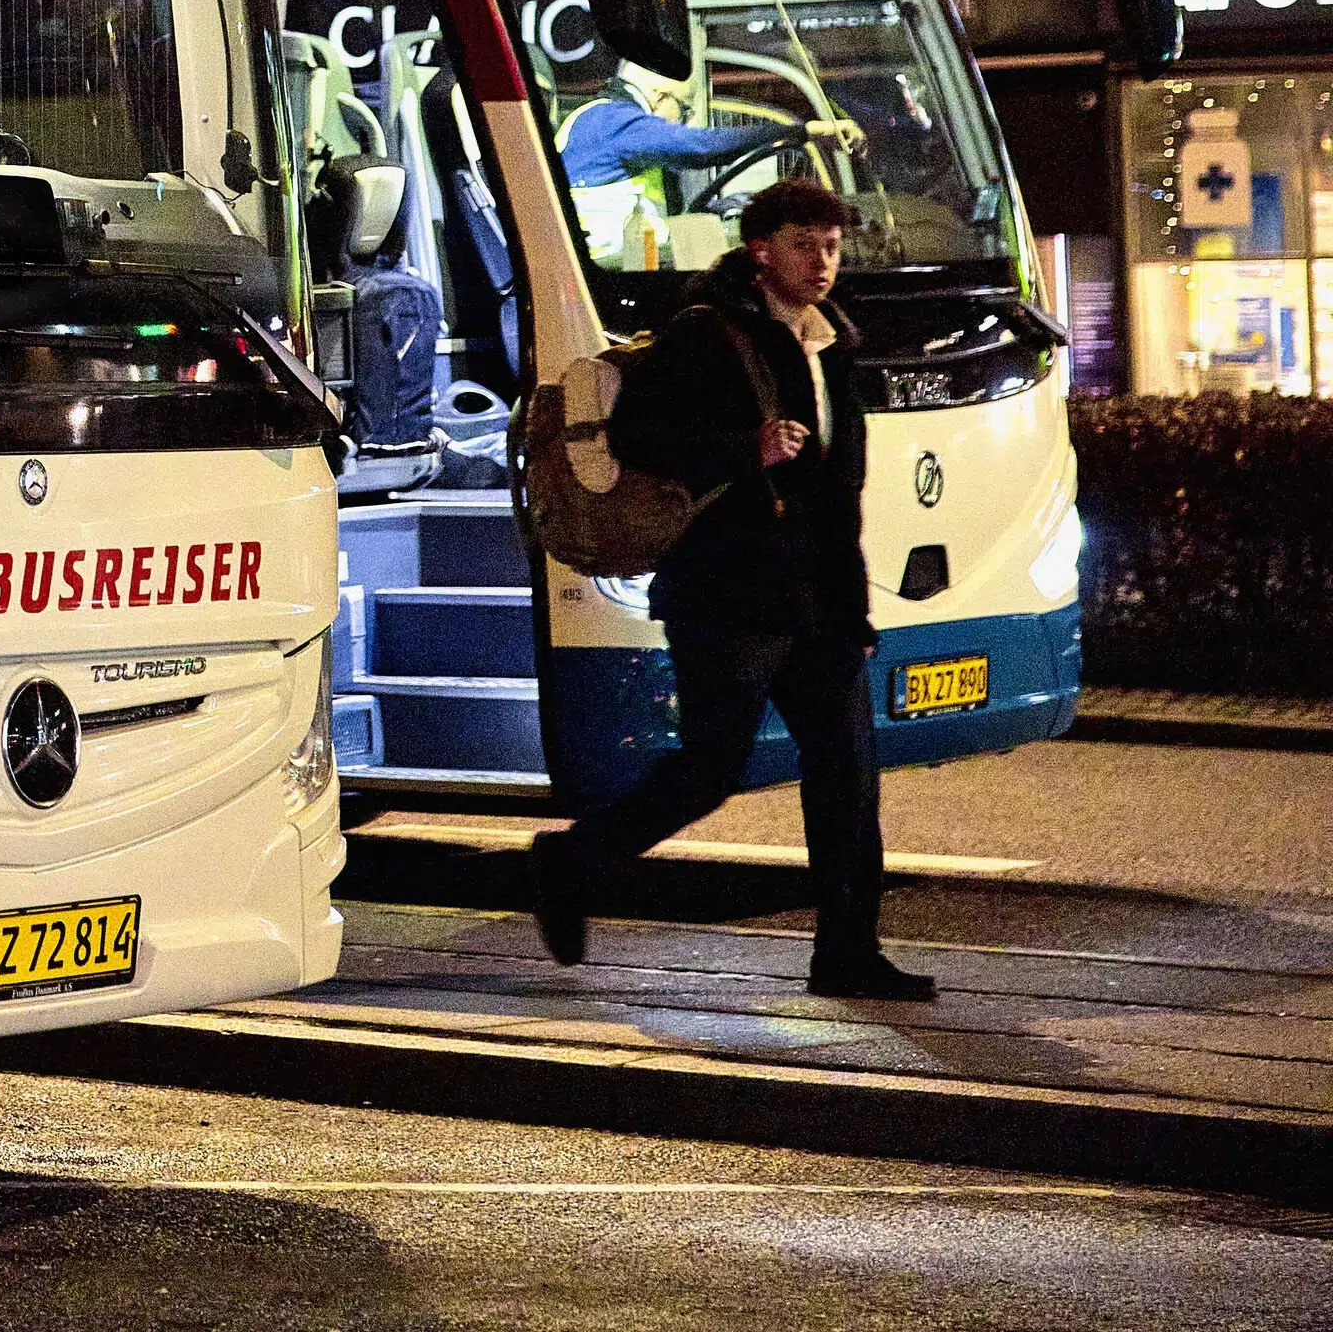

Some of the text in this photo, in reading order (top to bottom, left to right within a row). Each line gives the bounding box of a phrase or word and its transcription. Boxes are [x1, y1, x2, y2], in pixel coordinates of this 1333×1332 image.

[90, 657, 207, 683] TOURISMO
[908, 673, 932, 705] BX
[935, 670, 954, 701] 27
[29, 920, 66, 972] 72
[73, 912, 132, 967] 814
